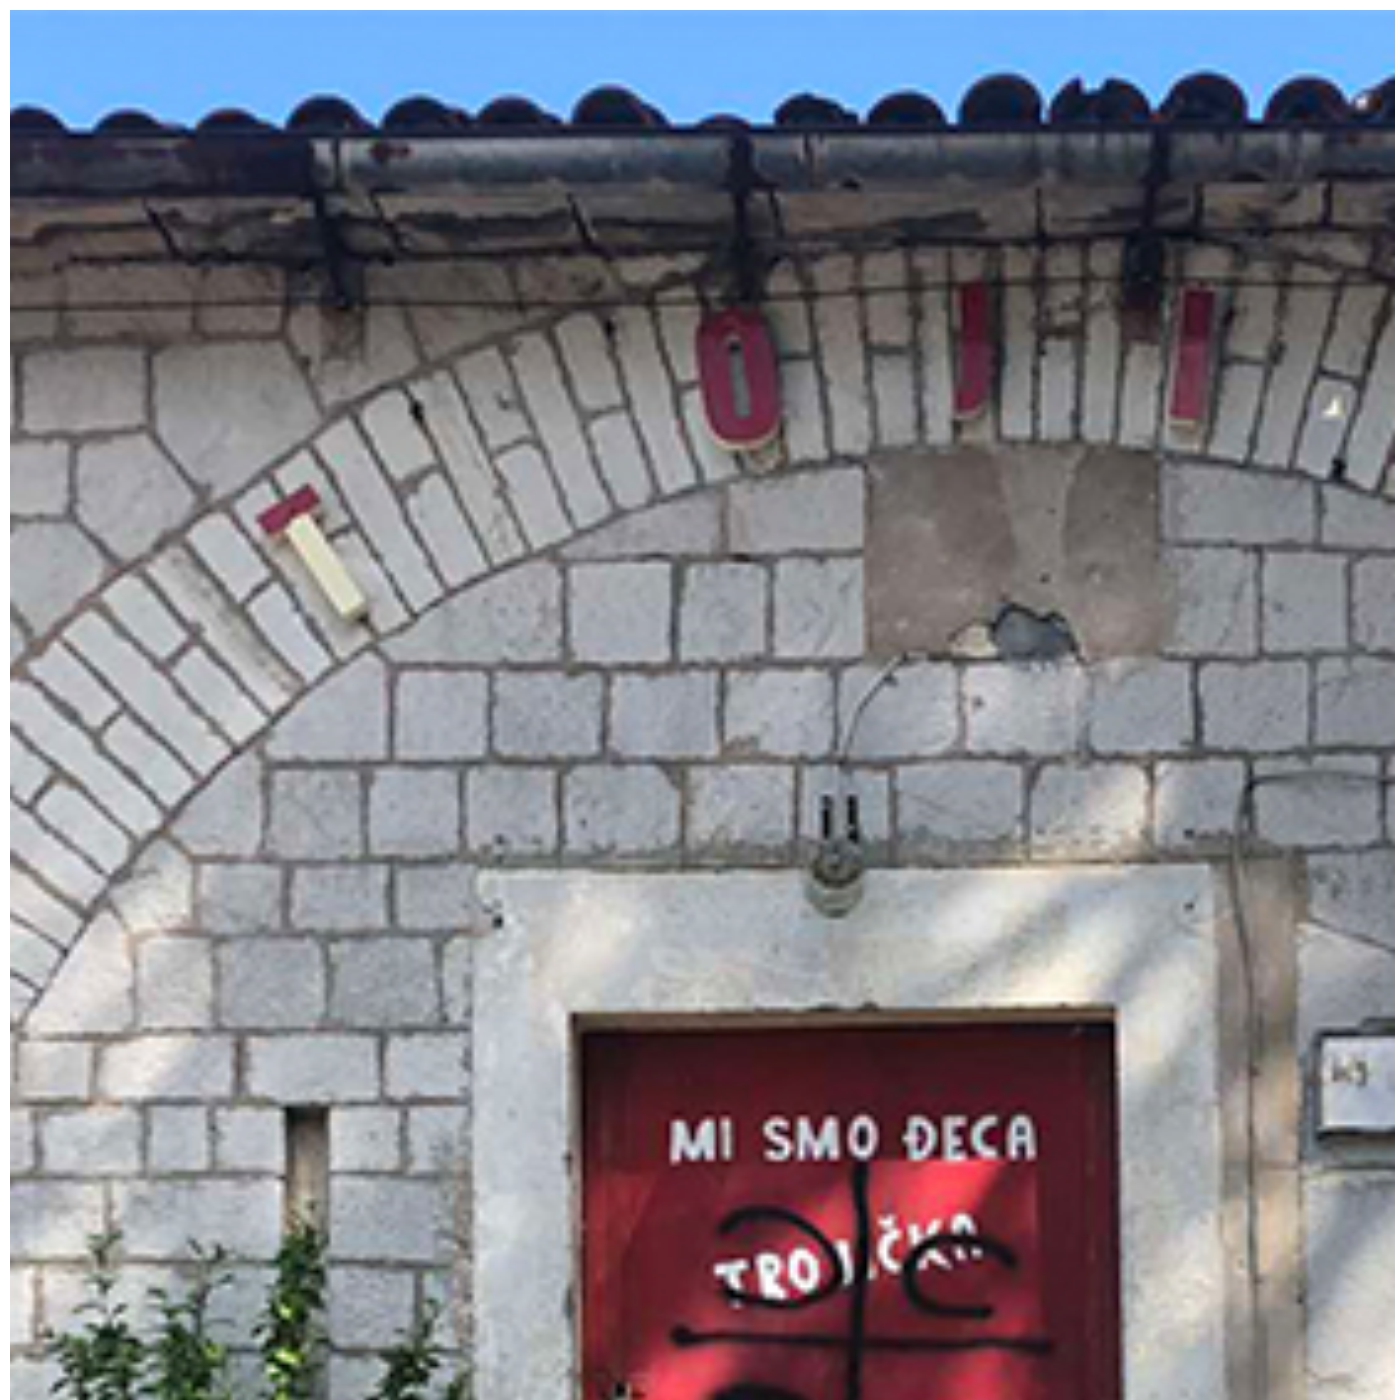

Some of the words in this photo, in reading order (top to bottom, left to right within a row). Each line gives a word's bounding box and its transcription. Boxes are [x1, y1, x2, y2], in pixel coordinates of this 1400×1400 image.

[669, 1117, 733, 1164] MI
[762, 1115, 878, 1161] SMO
[903, 1114, 1037, 1161] ĐECA
[713, 1212, 985, 1308] TROJČKA
